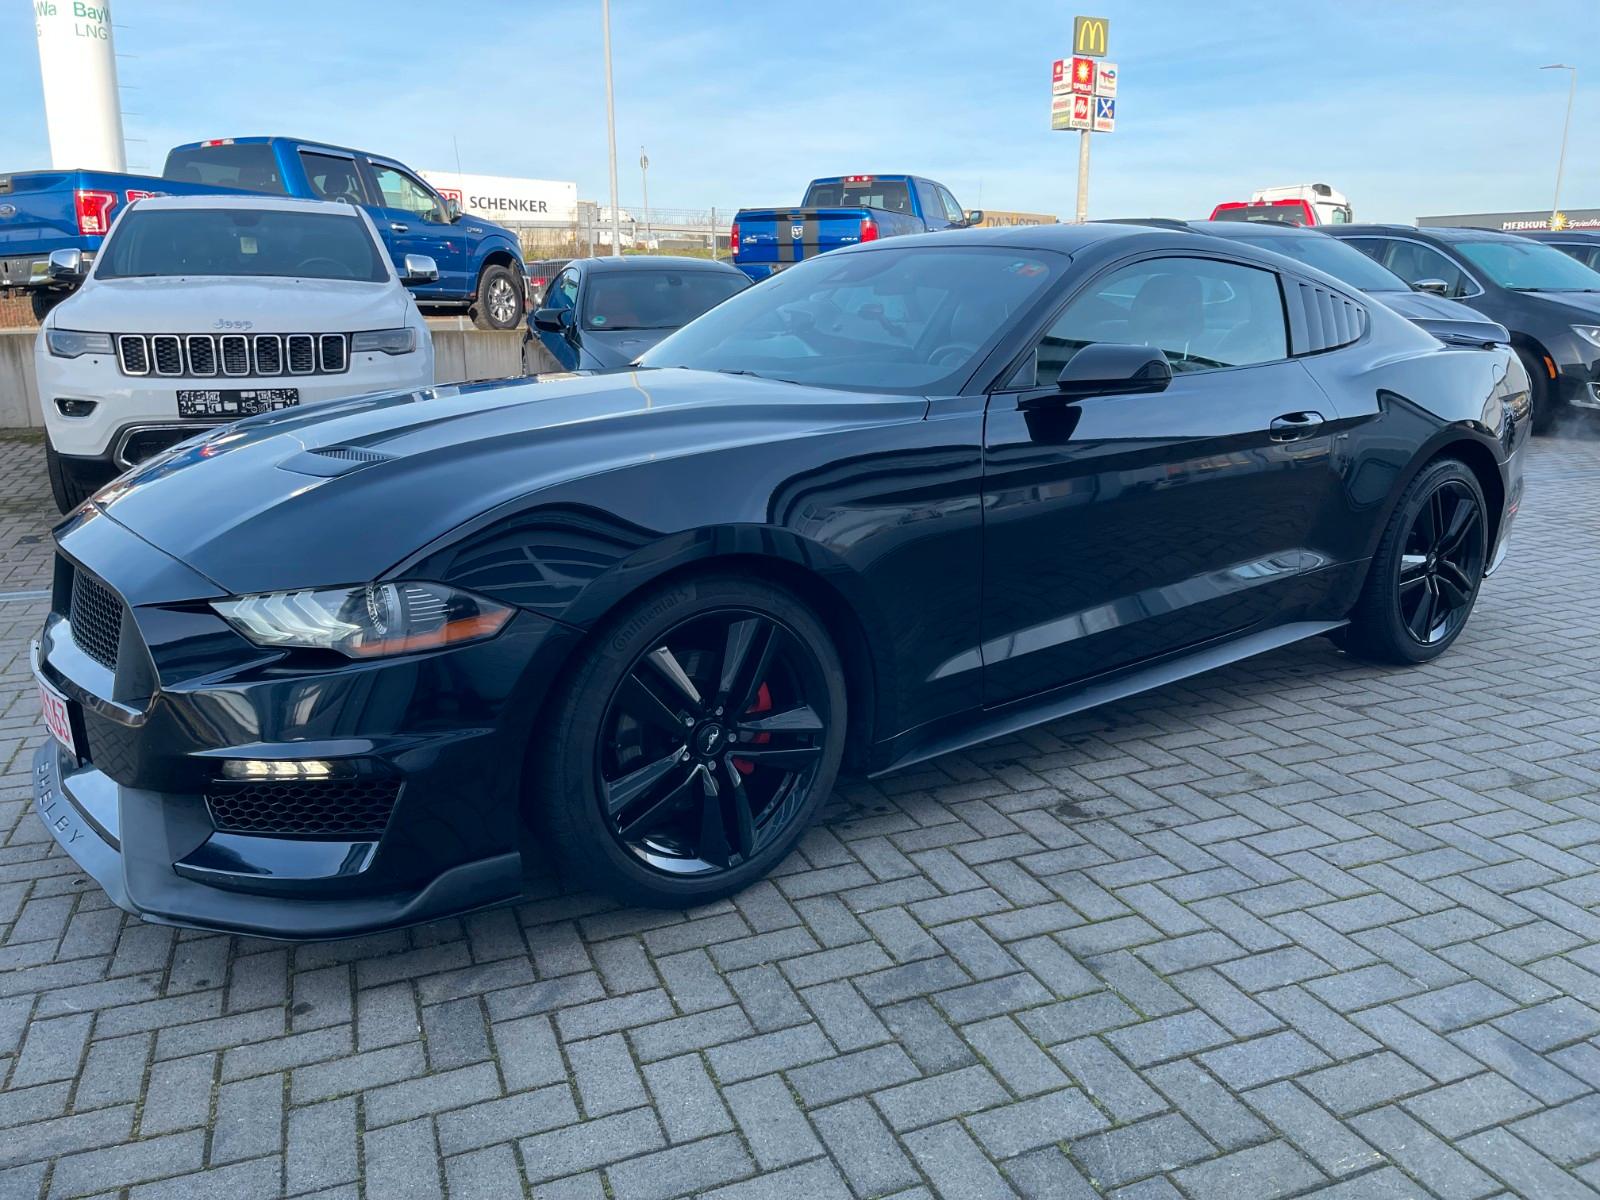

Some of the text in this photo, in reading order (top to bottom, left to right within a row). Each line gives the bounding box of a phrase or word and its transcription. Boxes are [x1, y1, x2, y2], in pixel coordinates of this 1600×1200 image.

[75, 23, 108, 40] LNG
[470, 196, 548, 213] SCHENKER
[1503, 220, 1547, 230] MERKUR
[213, 318, 253, 331] Jeep
[37, 761, 85, 844] SHELBY
